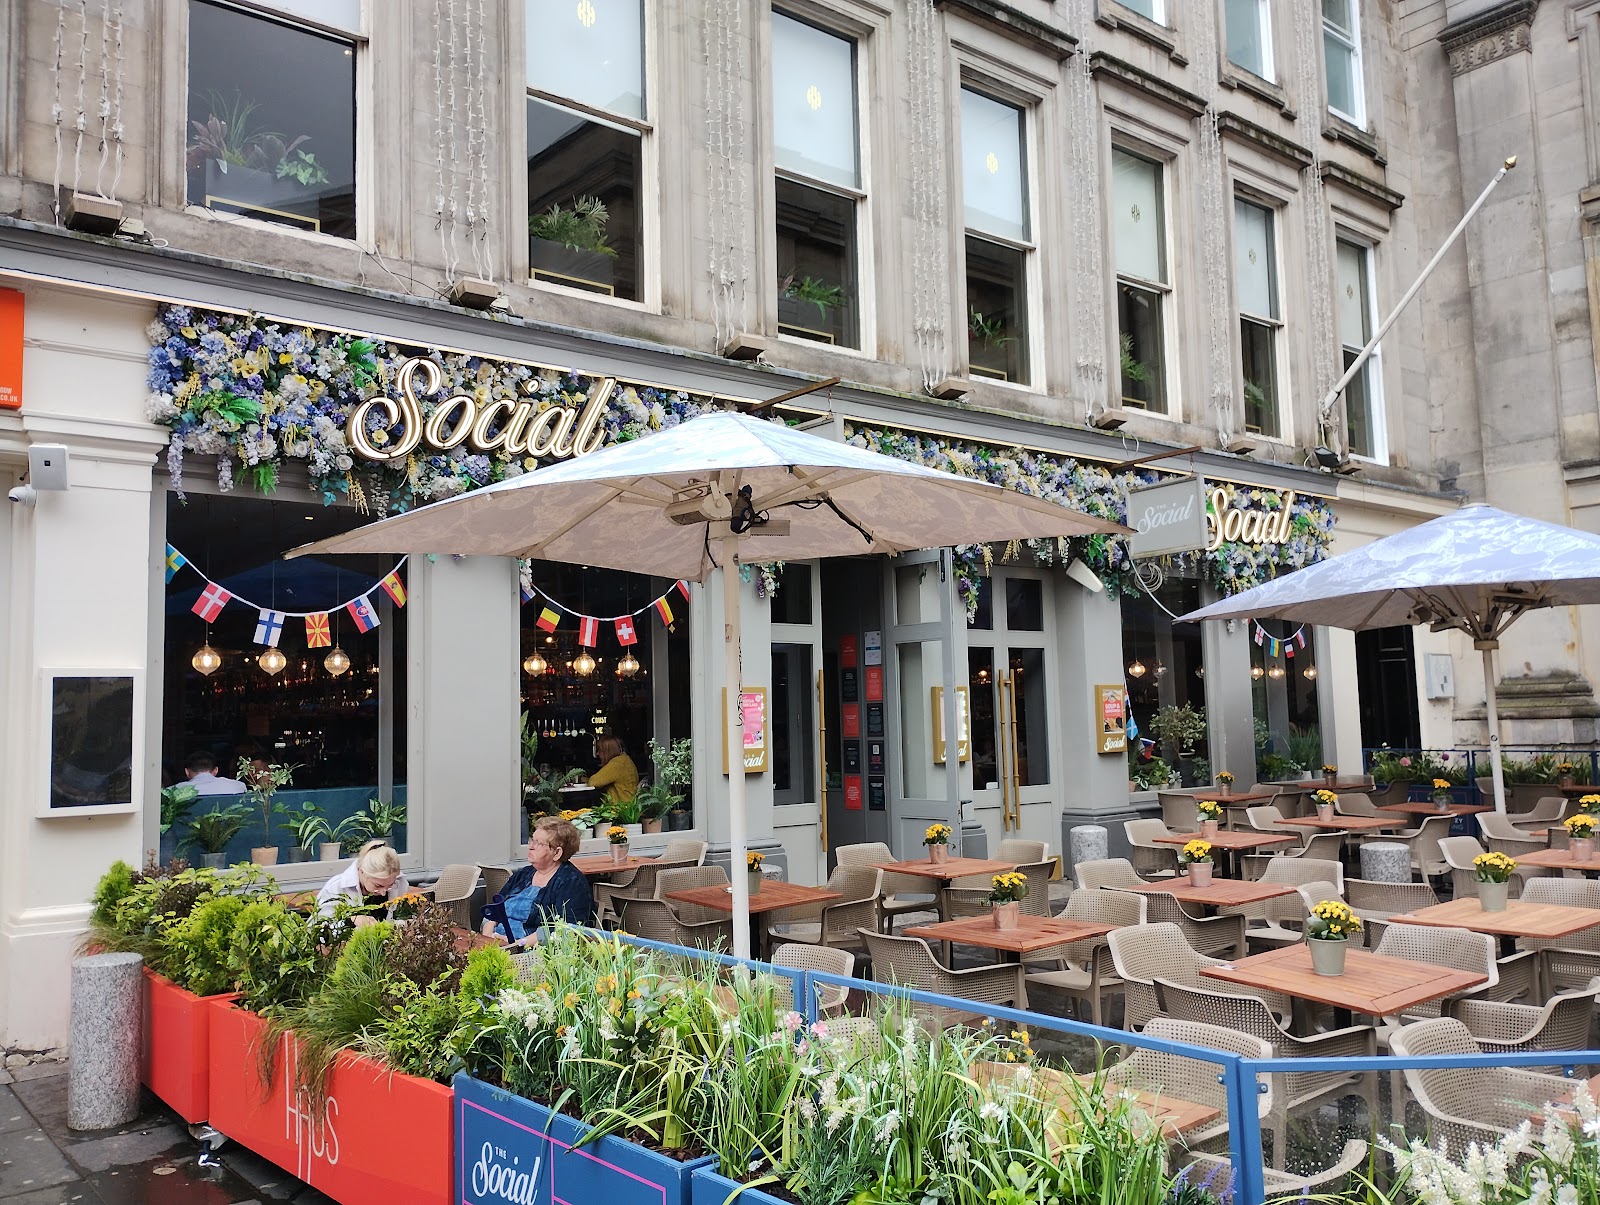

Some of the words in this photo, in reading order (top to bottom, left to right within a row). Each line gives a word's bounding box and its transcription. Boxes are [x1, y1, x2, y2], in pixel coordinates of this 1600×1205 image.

[348, 356, 615, 460] Social
[1137, 494, 1195, 535] Social
[1206, 487, 1294, 551] Social
[1103, 734, 1126, 751] Social
[472, 1141, 541, 1205] Social
[495, 1146, 507, 1160] THE
